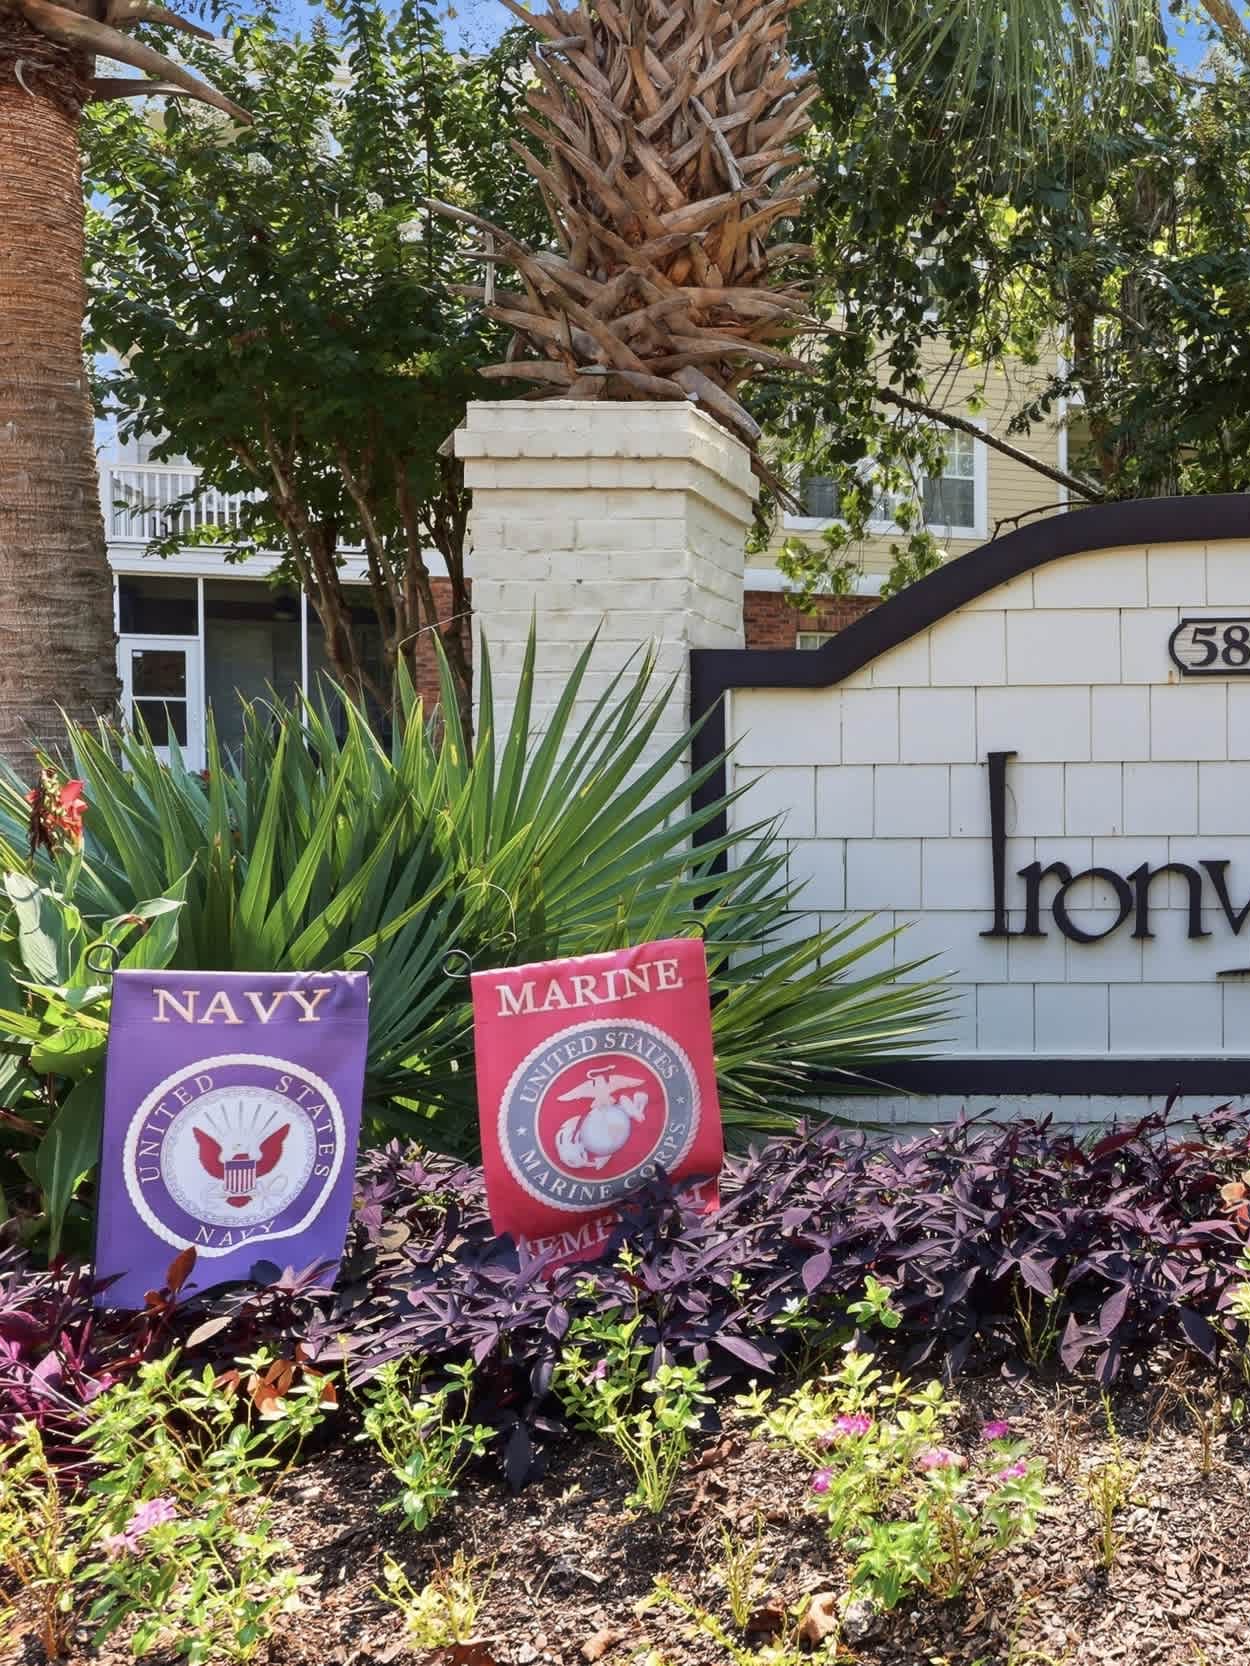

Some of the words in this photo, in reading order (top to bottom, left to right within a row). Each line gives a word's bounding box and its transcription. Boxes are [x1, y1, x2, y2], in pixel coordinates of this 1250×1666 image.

[152, 988, 332, 1025] NAVY
[496, 958, 684, 1018] MARINE
[520, 1034, 598, 1104] UNITED
[603, 1031, 681, 1080] STATES
[139, 1074, 215, 1184] UNITED
[274, 1074, 336, 1179] STATES
[518, 1150, 613, 1202] MARINE
[623, 1121, 686, 1190] CORPS
[195, 1219, 276, 1247] NAVY
